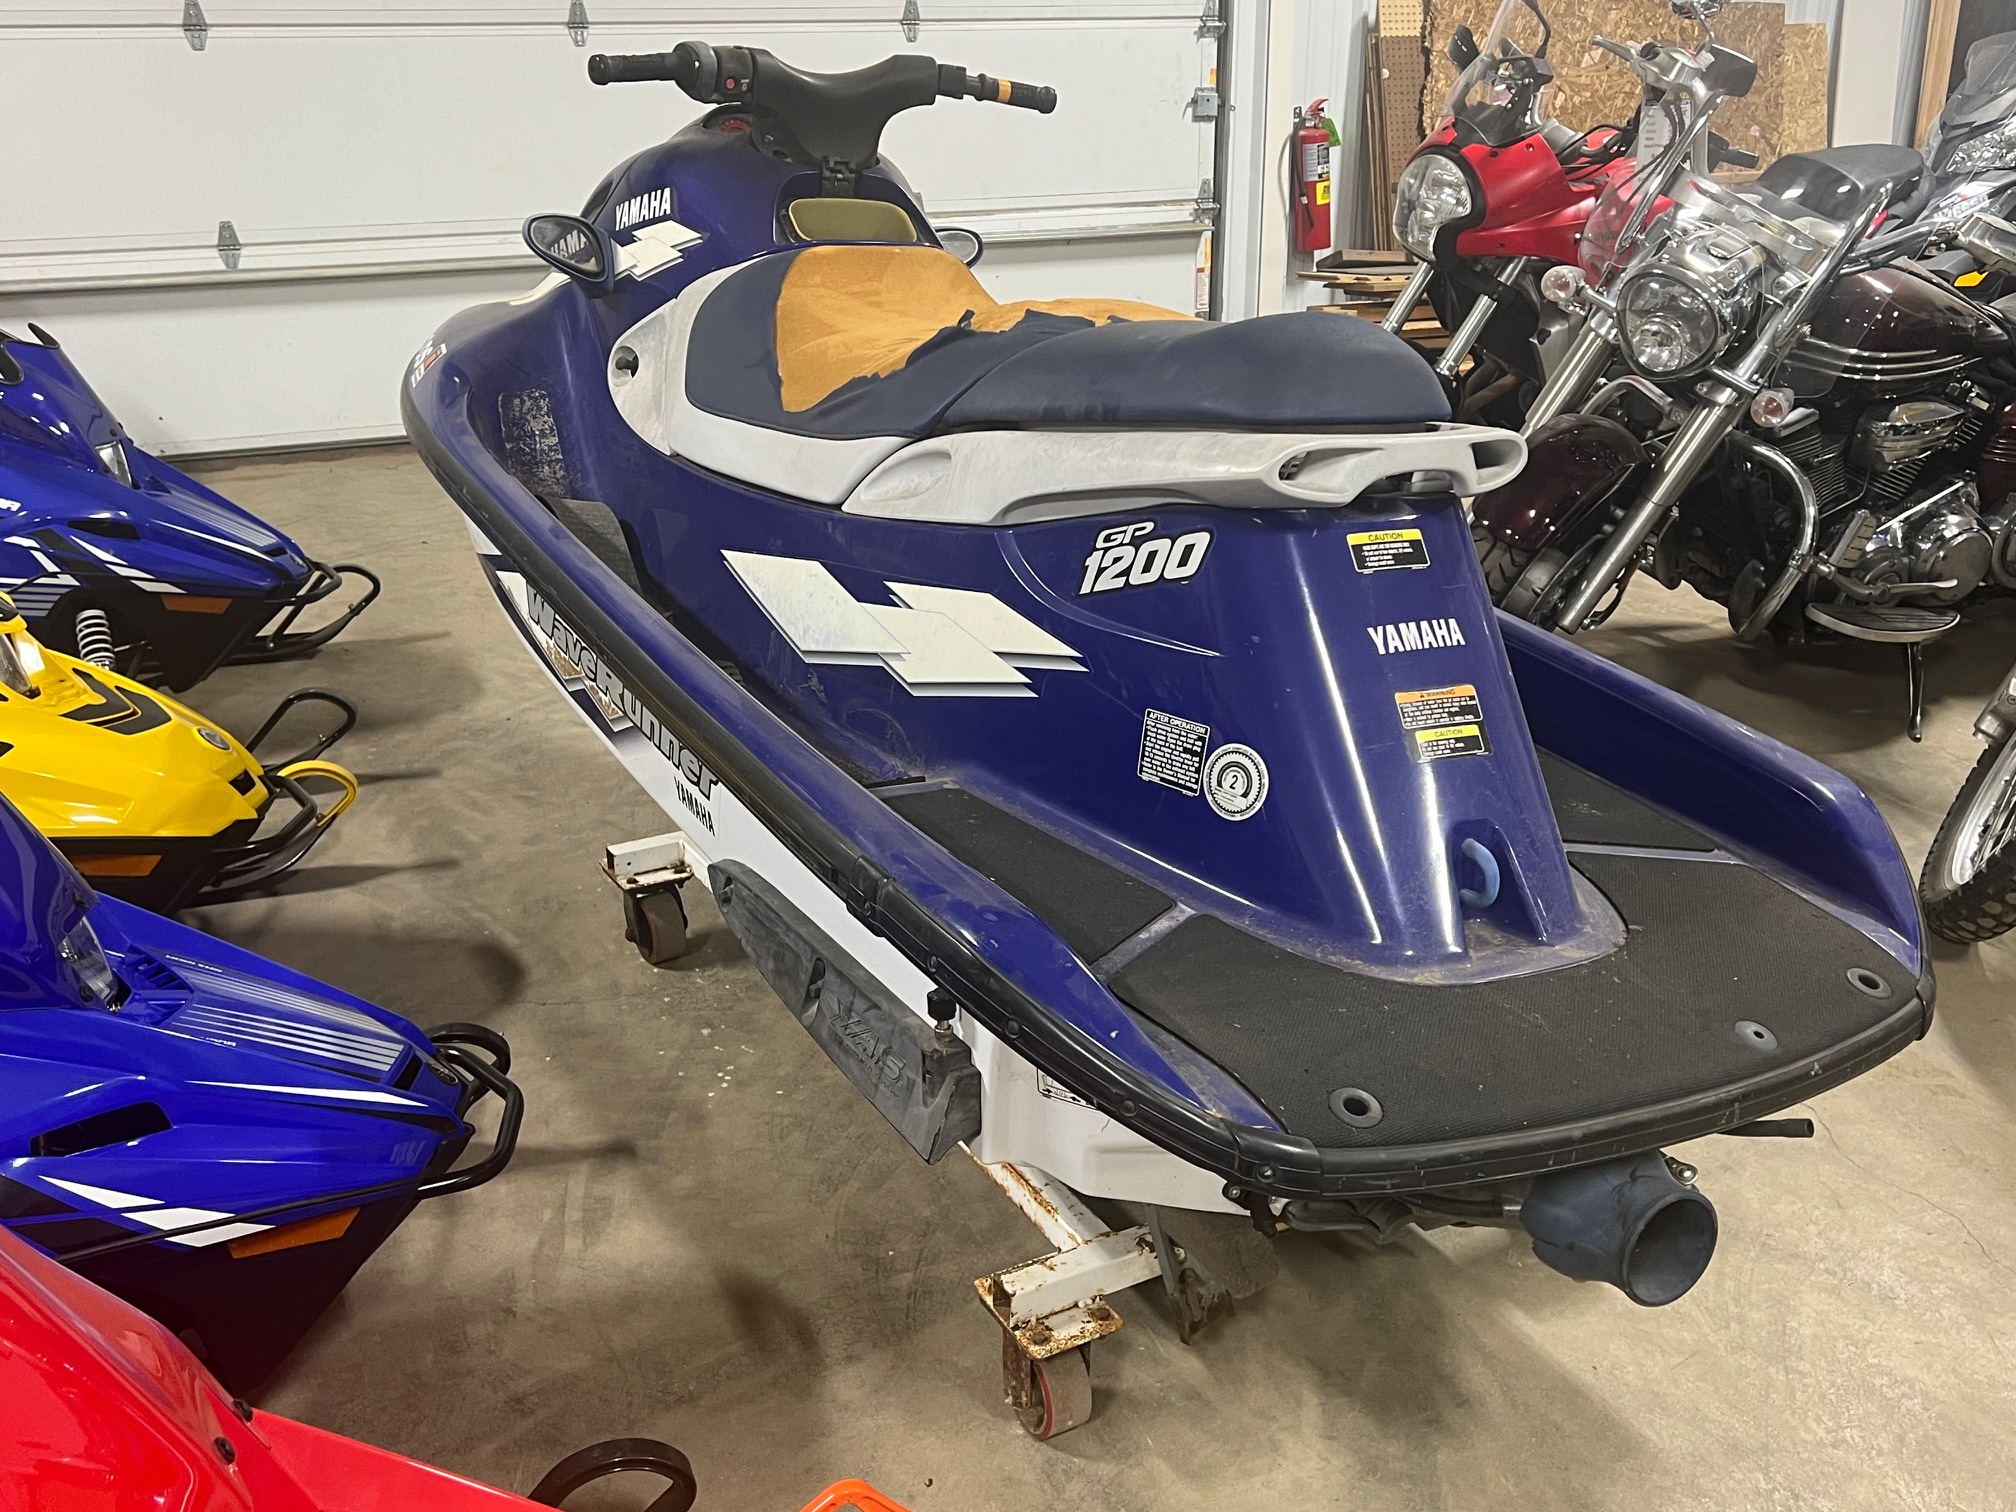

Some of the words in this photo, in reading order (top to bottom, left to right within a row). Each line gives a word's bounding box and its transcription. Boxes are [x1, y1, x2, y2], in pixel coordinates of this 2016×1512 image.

[615, 187, 671, 231] YAMAHA
[1095, 521, 1155, 549] GP
[1368, 533, 1404, 542] CAUTION
[1078, 531, 1211, 595] 1200
[1366, 618, 1466, 655] YAMAHA
[526, 583, 720, 801] WaveRunner
[1149, 712, 1169, 724] AFTER
[1170, 718, 1207, 735] OPERATION
[1434, 728, 1463, 738] CAUTION
[1229, 774, 1239, 790] 2
[673, 776, 716, 836] YAMAHA
